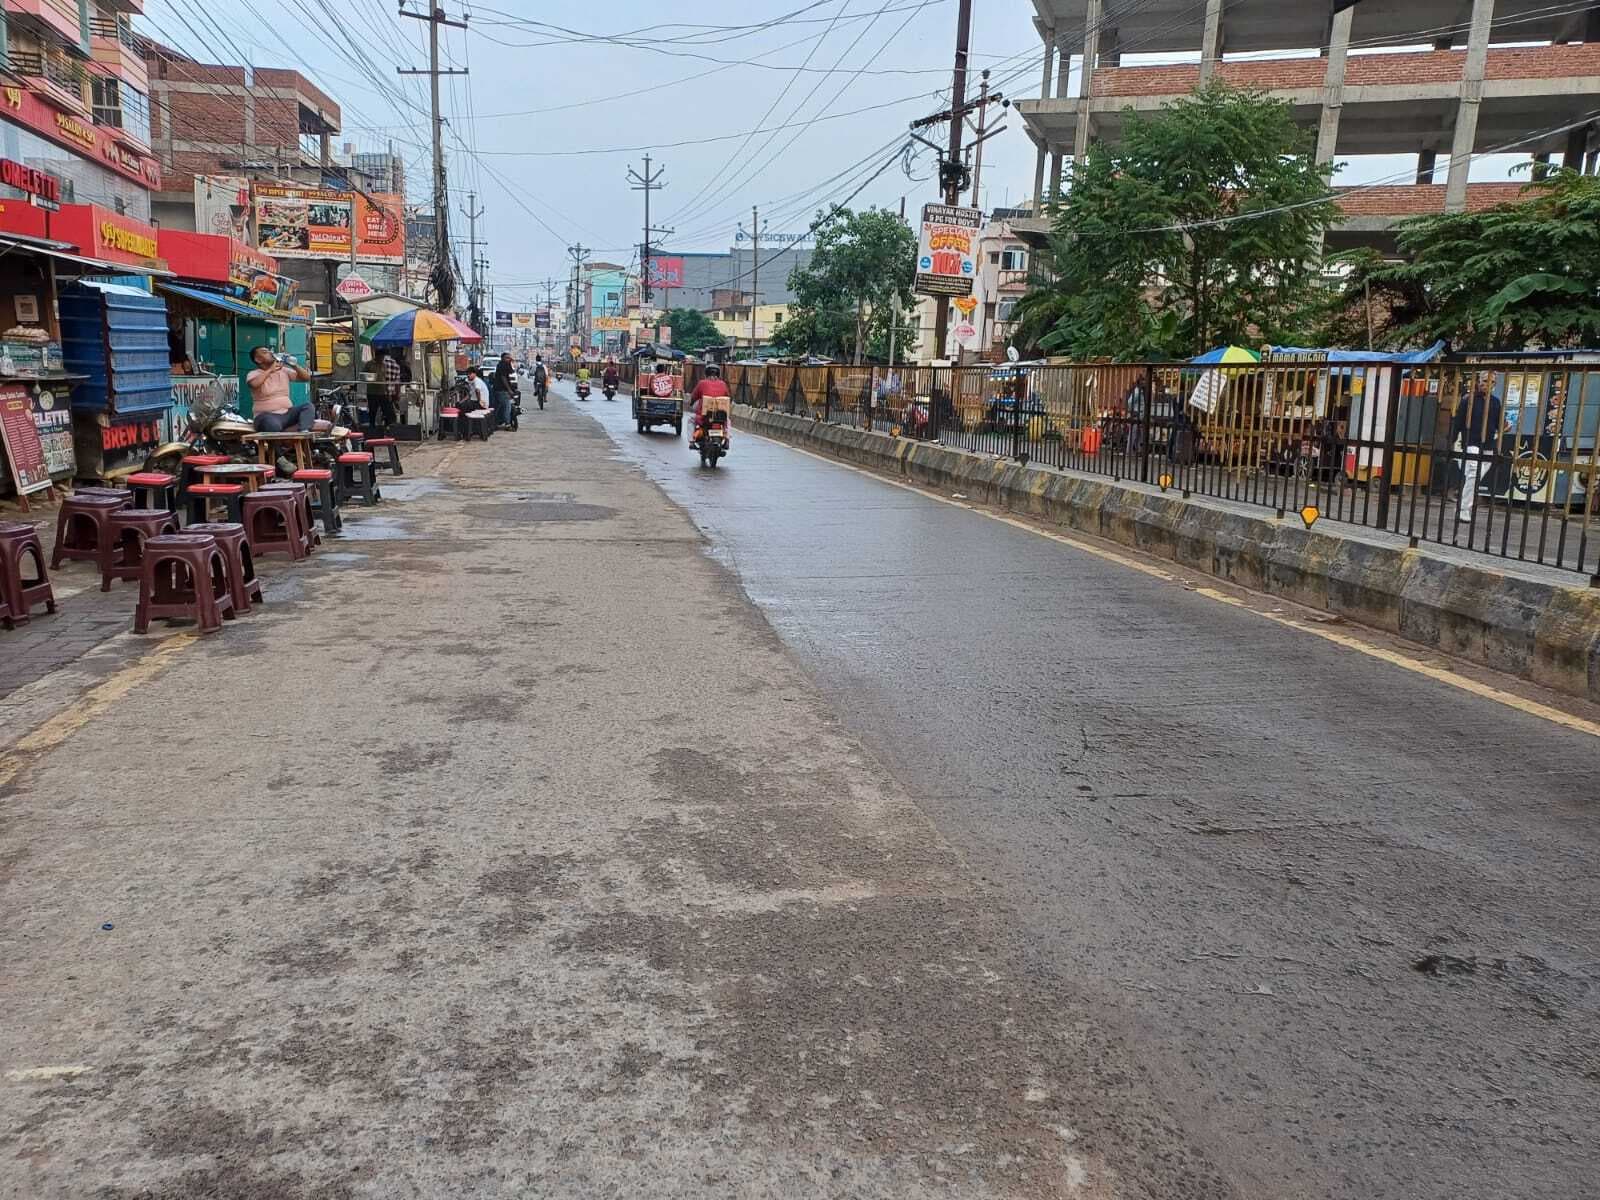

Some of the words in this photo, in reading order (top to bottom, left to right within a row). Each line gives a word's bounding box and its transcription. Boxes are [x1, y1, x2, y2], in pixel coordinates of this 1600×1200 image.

[927, 206, 955, 216] VINAYAK
[955, 209, 979, 219] HOSTEL
[932, 225, 970, 238] SPECIAL
[930, 235, 970, 253] OFFER
[103, 427, 138, 449] BREW
